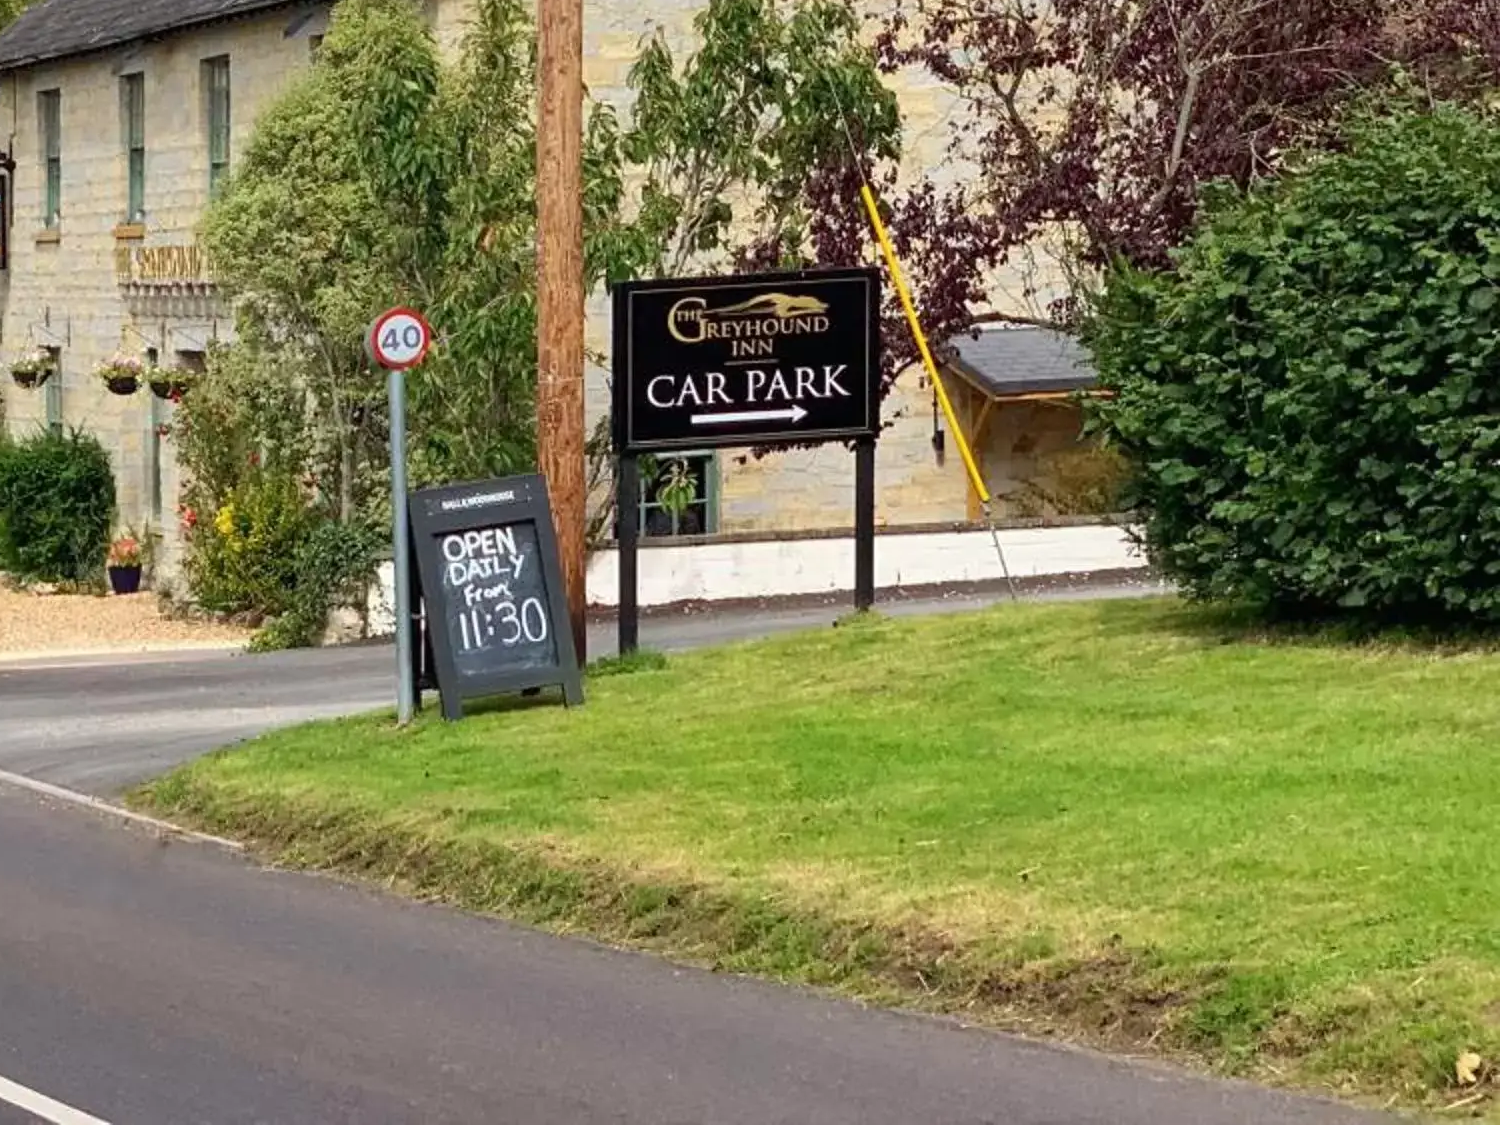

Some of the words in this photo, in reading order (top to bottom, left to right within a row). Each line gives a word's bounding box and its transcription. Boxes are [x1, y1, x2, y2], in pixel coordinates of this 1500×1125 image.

[667, 296, 830, 343] GREYHOUND
[676, 310, 703, 323] THE
[382, 324, 421, 352] 40
[731, 338, 774, 357] INN
[646, 371, 734, 408] CAR
[745, 364, 851, 402] PARK
[442, 526, 517, 562] OPEN
[449, 554, 525, 586] DAILY
[460, 597, 547, 650] 11:30
